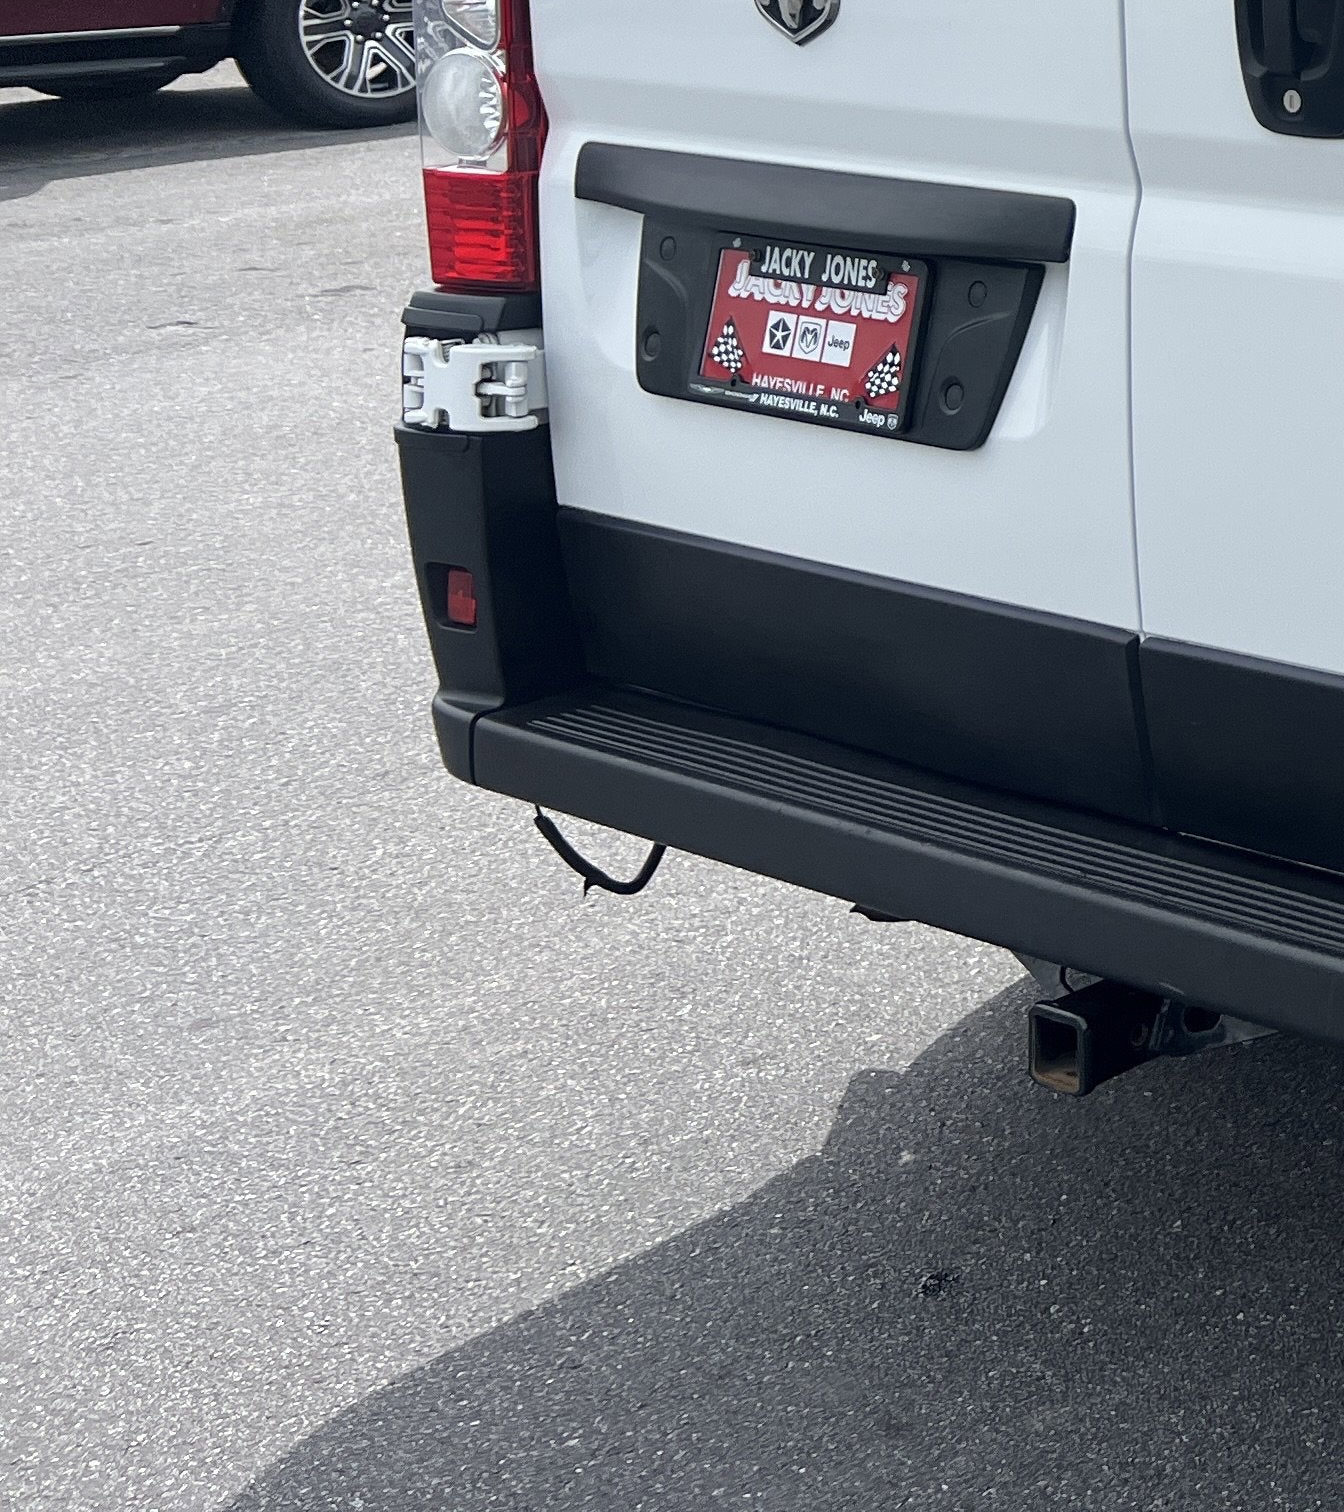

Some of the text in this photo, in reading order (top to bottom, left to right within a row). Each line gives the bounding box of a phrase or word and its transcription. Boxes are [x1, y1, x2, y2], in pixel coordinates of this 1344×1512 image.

[761, 245, 878, 289] JACKY JONES
[827, 337, 850, 351] Jeep
[759, 392, 818, 417] HAYESVILLE,
[819, 402, 840, 419] N.C.
[858, 408, 886, 427] Jeep
